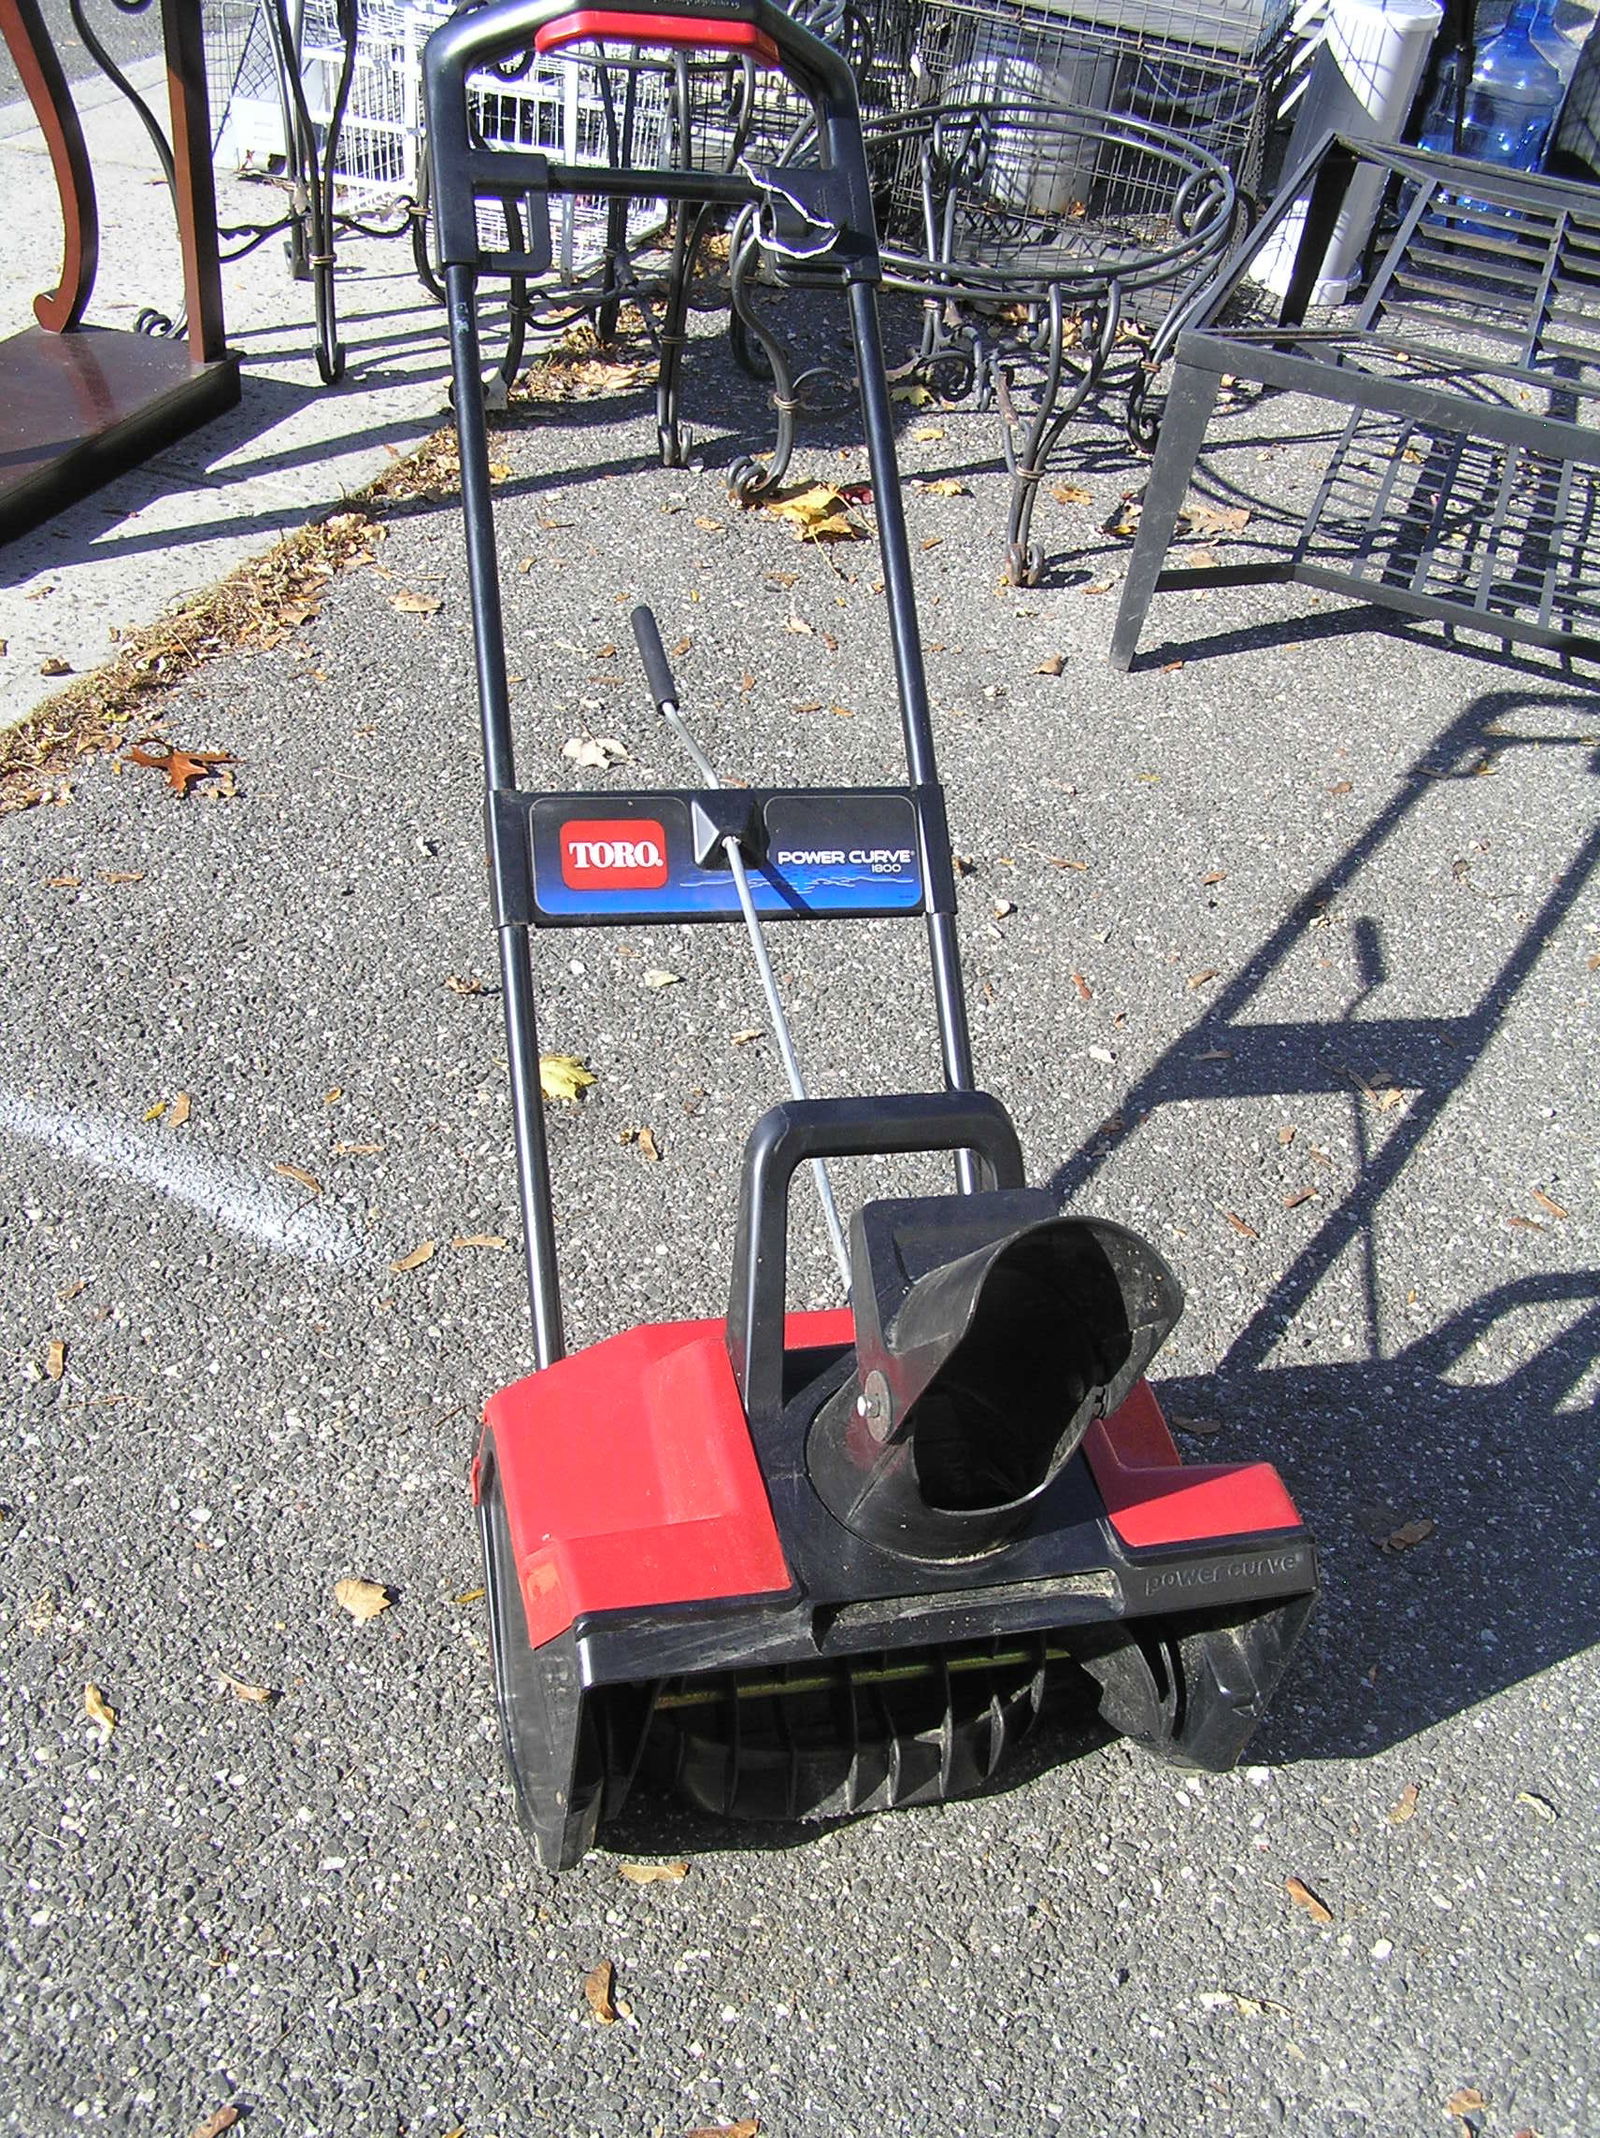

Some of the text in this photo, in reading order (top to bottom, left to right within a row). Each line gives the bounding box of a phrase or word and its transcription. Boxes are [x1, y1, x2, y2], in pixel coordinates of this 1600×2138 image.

[777, 850, 912, 865] POWER CURVE
[871, 863, 901, 873] 1800
